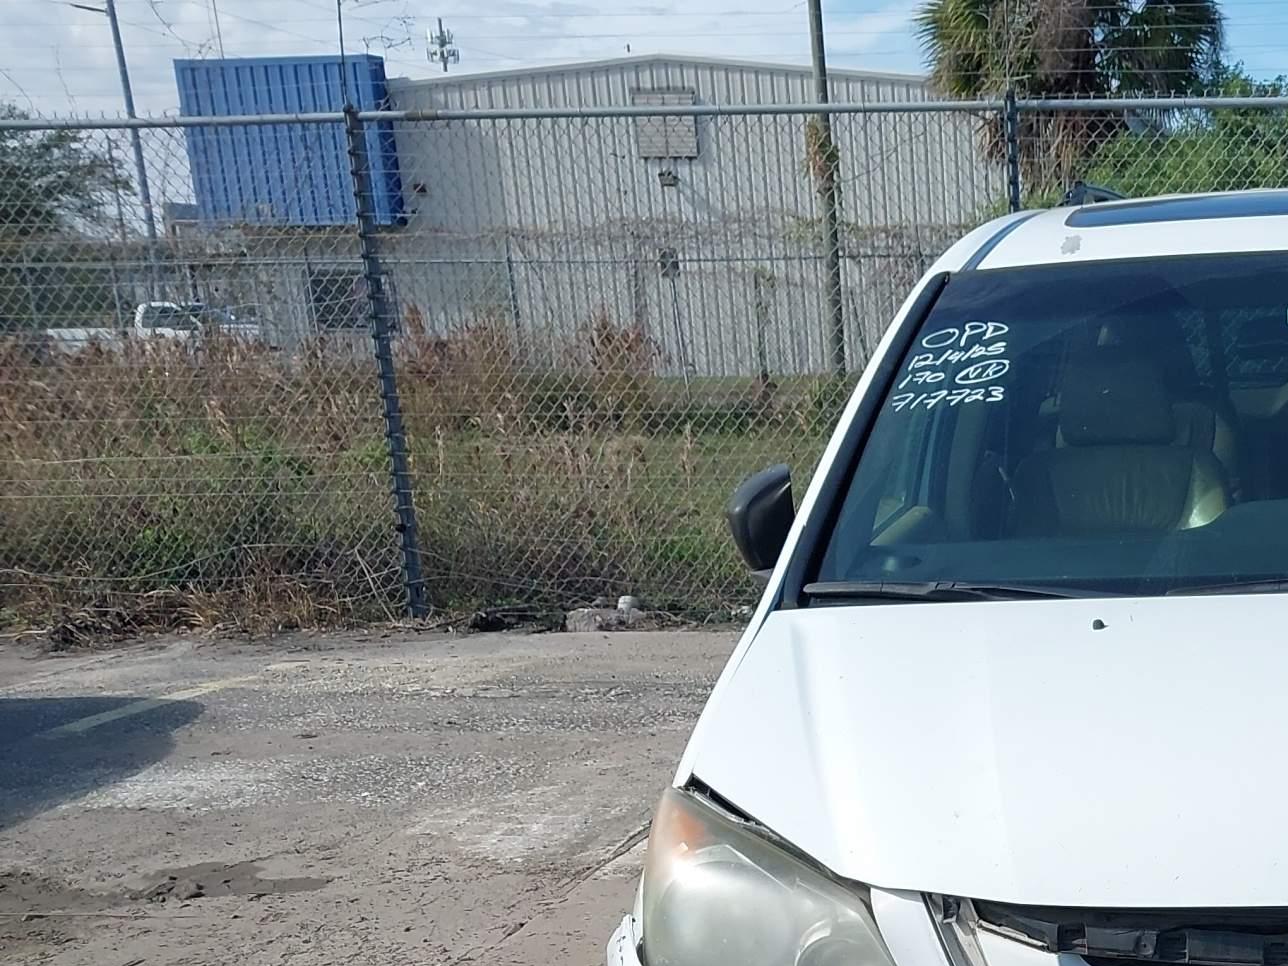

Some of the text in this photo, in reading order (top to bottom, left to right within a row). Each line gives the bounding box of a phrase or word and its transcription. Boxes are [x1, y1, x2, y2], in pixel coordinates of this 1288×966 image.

[922, 322, 1009, 348] OPD
[908, 342, 1007, 371] 12/4/25
[898, 371, 945, 389] 170
[892, 386, 1005, 412] 717723
